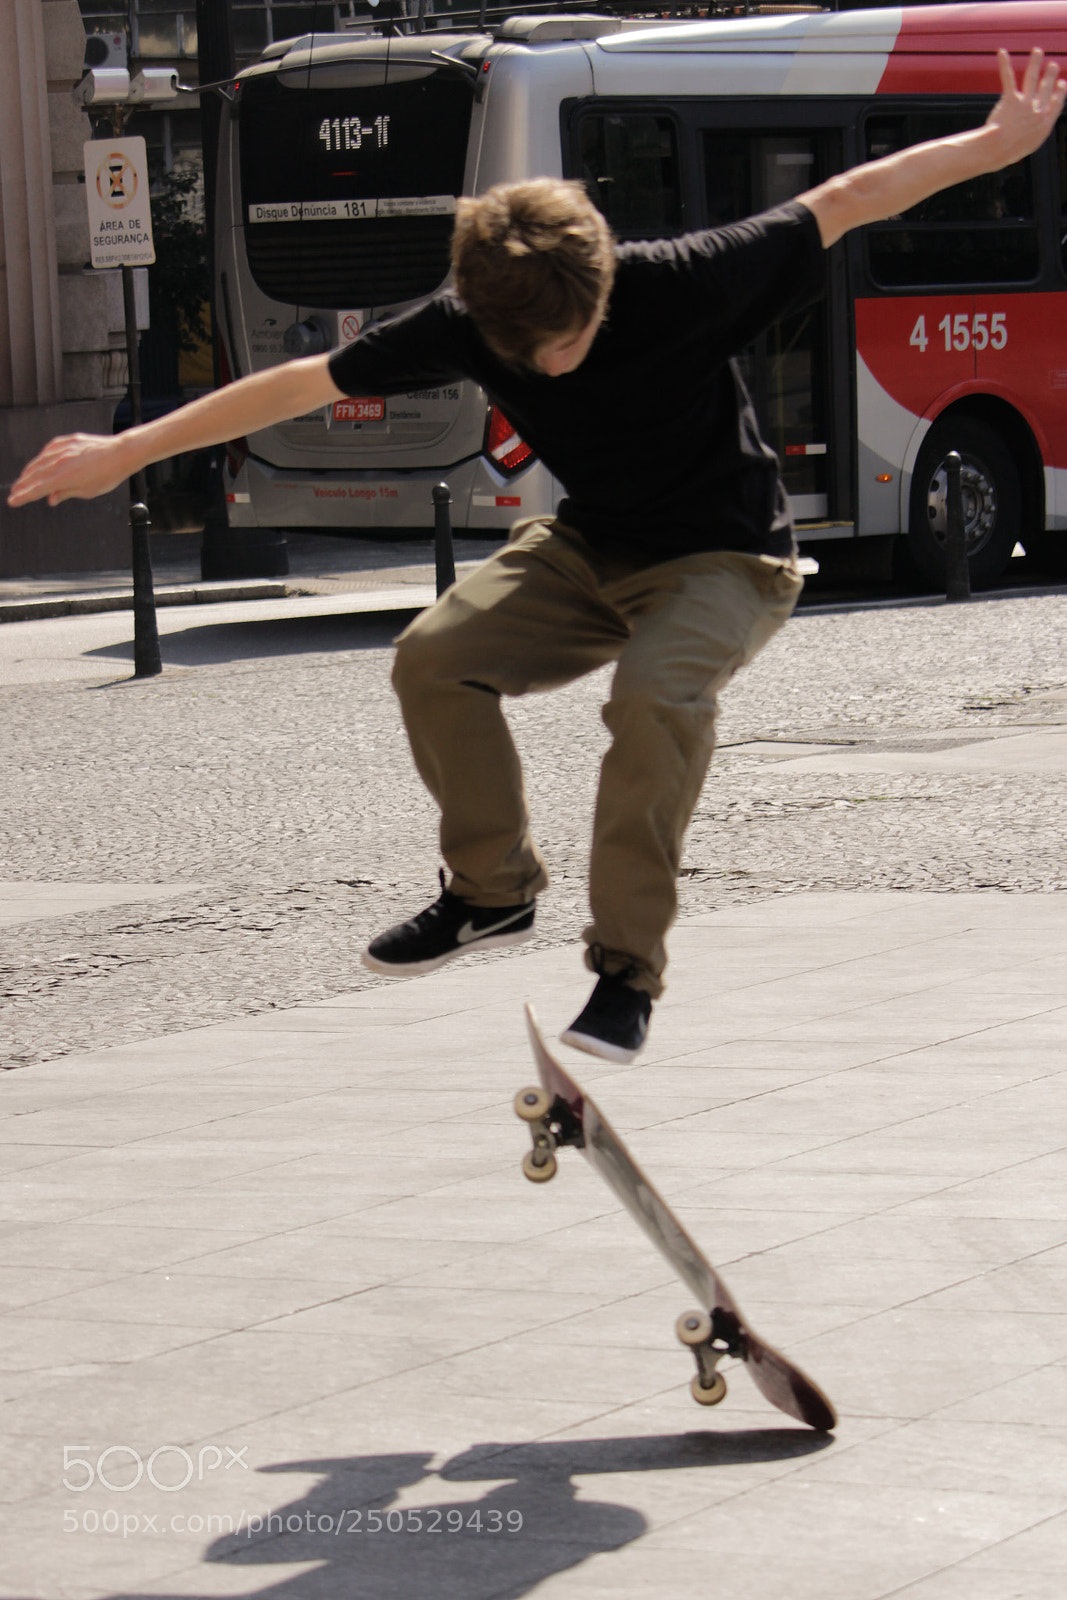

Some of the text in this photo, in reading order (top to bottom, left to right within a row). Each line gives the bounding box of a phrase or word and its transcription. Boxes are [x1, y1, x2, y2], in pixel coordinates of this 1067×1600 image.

[256, 207, 288, 221] Disque
[291, 203, 337, 218] Denúncia
[344, 202, 367, 217] 181
[100, 219, 141, 231] ÁREA DE
[94, 233, 149, 246] SEGURANÇA
[909, 312, 1008, 352] 4 1555
[406, 389, 459, 400] Central 156
[335, 403, 382, 418] FFN-3469
[379, 486, 399, 498] 15m
